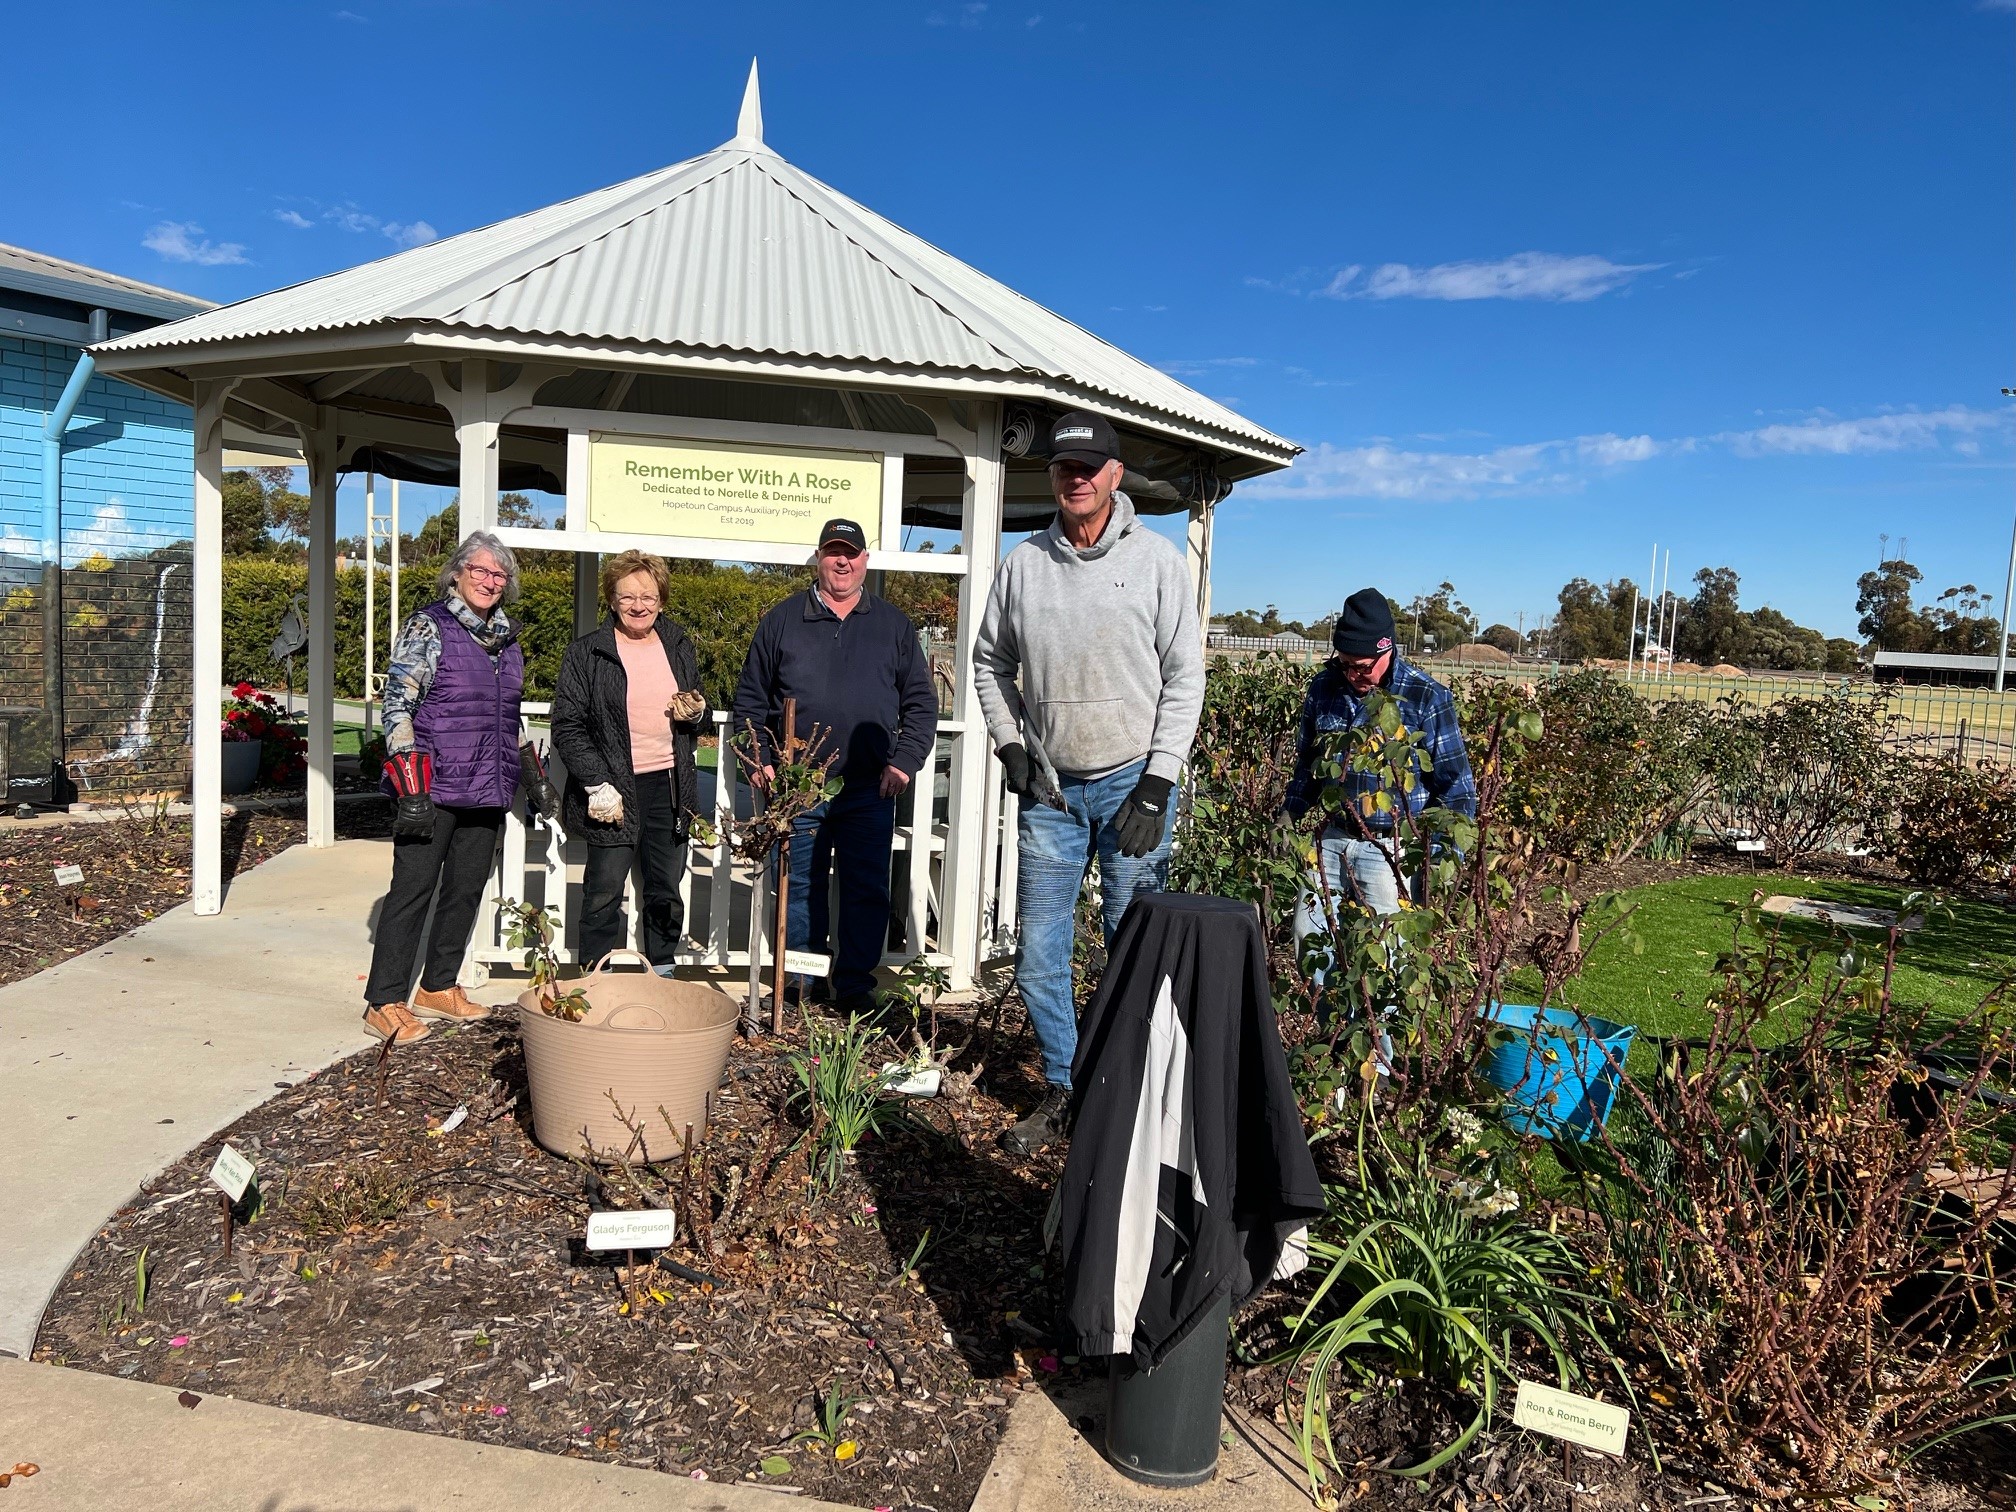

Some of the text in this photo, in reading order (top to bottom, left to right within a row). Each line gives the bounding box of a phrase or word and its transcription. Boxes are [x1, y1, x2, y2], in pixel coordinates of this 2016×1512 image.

[625, 460, 852, 491] Remember With A Rose
[642, 482, 832, 504] Dedicated to Norelle & Dennis Huf
[662, 500, 811, 518] Hopetoun Campus Auxiliary Project
[720, 516, 755, 527] Est 2019
[785, 957, 800, 967] etty
[800, 959, 825, 969] Hallam
[593, 1224, 670, 1235] Gladys Ferguson
[1525, 1400, 1545, 1413] Ron
[1547, 1406, 1555, 1417] &
[1556, 1409, 1586, 1426] Roma
[1588, 1418, 1617, 1436] Berry
